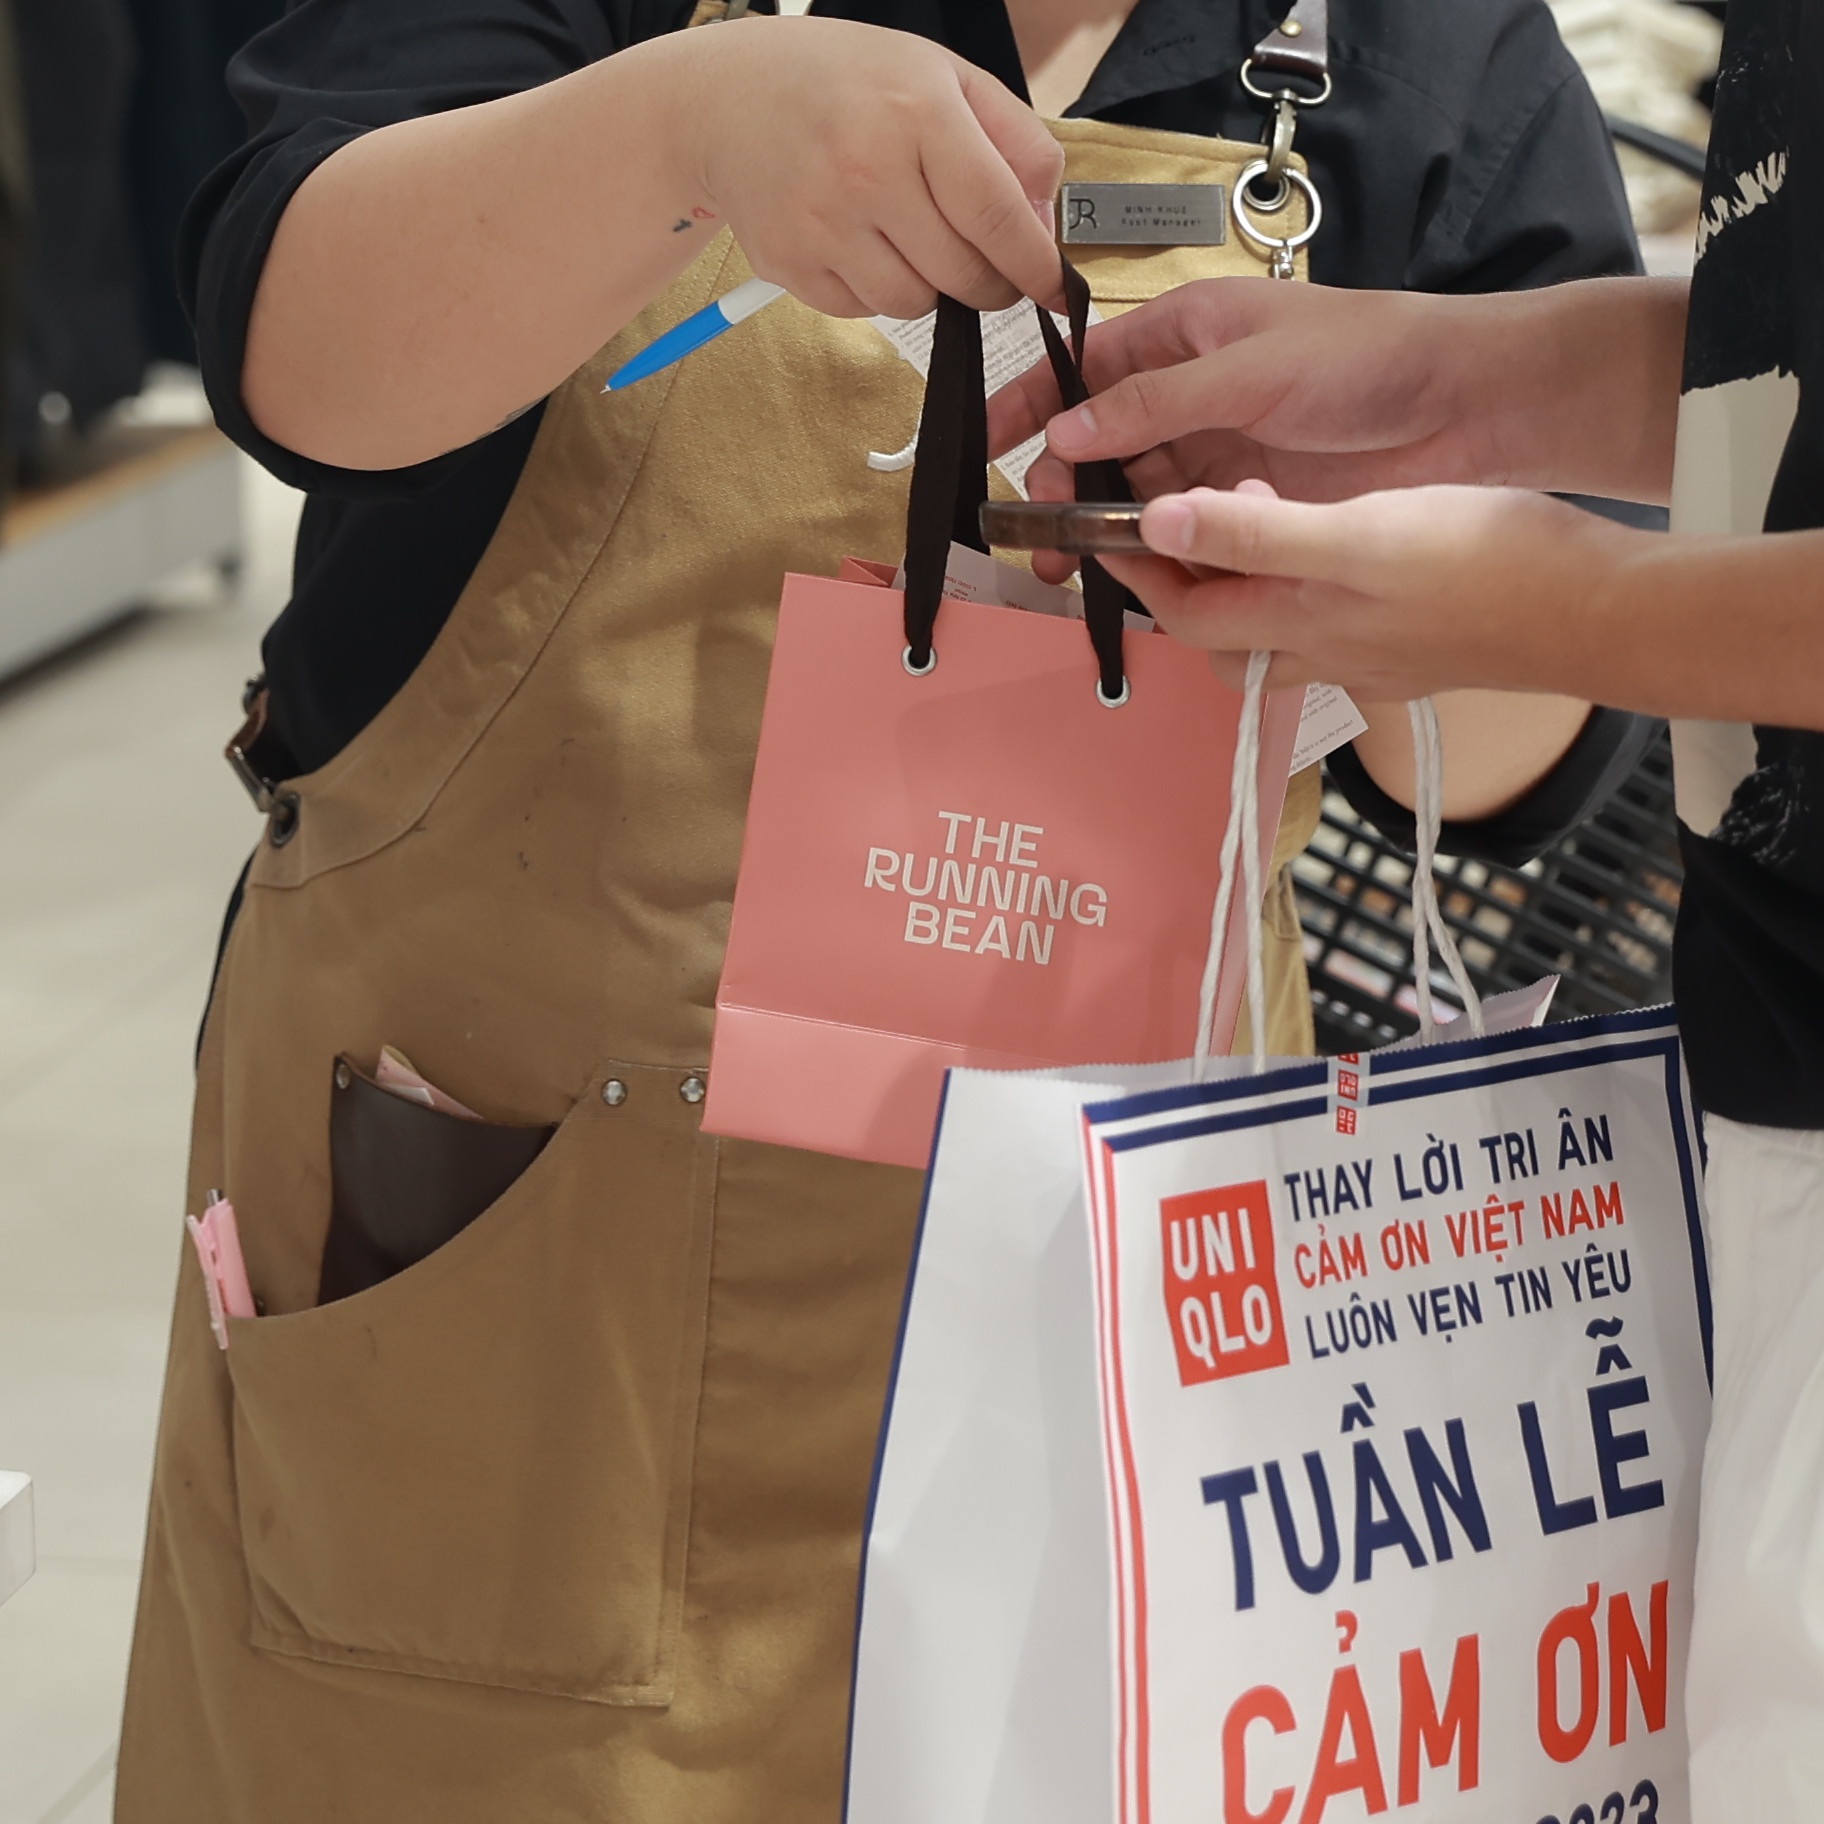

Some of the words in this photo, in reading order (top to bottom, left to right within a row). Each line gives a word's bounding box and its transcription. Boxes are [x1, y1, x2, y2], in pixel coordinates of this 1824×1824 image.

[864, 847, 1108, 928] RUNNING
[938, 810, 1044, 869] THE
[904, 902, 1054, 965] BEAN
[1284, 1158, 1374, 1222] THAY
[1393, 1132, 1465, 1201] LỜI
[1479, 1127, 1540, 1184] TRI
[1557, 1108, 1615, 1171] ÂN
[1170, 1207, 1257, 1281] UNI
[1294, 1223, 1369, 1289] CẢM
[1380, 1218, 1431, 1271] ƠN
[1444, 1194, 1526, 1263] VIỆT
[1540, 1181, 1624, 1239] NAM
[1180, 1284, 1274, 1370] QLO
[1305, 1292, 1398, 1360] LUÔN
[1407, 1280, 1483, 1343] VẸN
[1495, 1266, 1553, 1318] TIN
[1562, 1242, 1633, 1302] YÊU
[1200, 1381, 1494, 1612] TUẦN
[1517, 1316, 1666, 1536] LỄ
[1220, 1609, 1481, 1824] CẢM
[1536, 1579, 1670, 1764] ƠN
